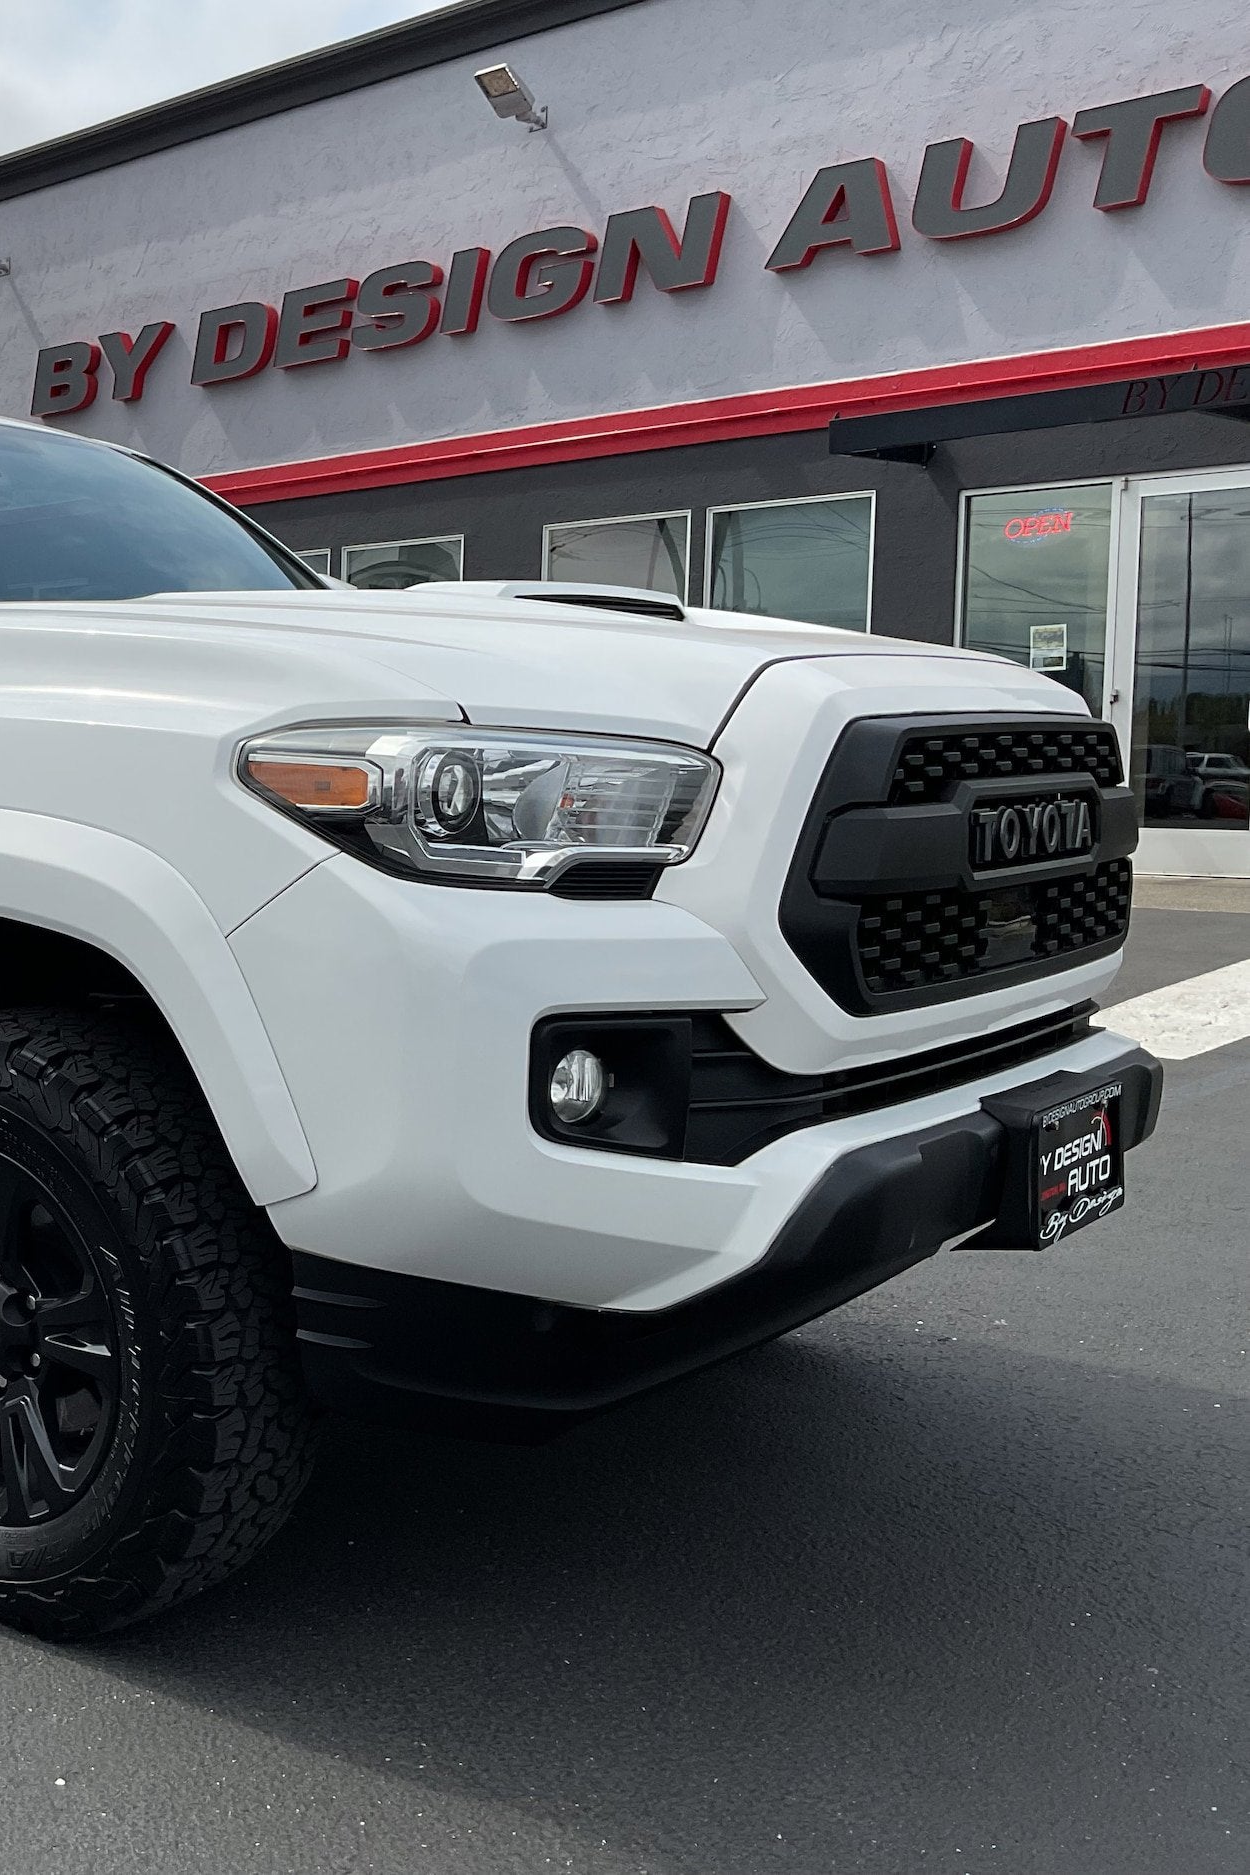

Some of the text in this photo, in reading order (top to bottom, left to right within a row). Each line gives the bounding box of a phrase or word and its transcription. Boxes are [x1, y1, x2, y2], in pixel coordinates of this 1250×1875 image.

[30, 321, 176, 417] BY
[190, 190, 731, 387] DESIGN
[1120, 375, 1183, 415] BY
[1004, 511, 1073, 539] OPEN
[971, 799, 1092, 864] TOYOTA
[1053, 1129, 1102, 1172] DESIGN
[1067, 1154, 1111, 1197] AUTO
[1040, 1210, 1068, 1244] By
[1068, 1186, 1124, 1222] Design
